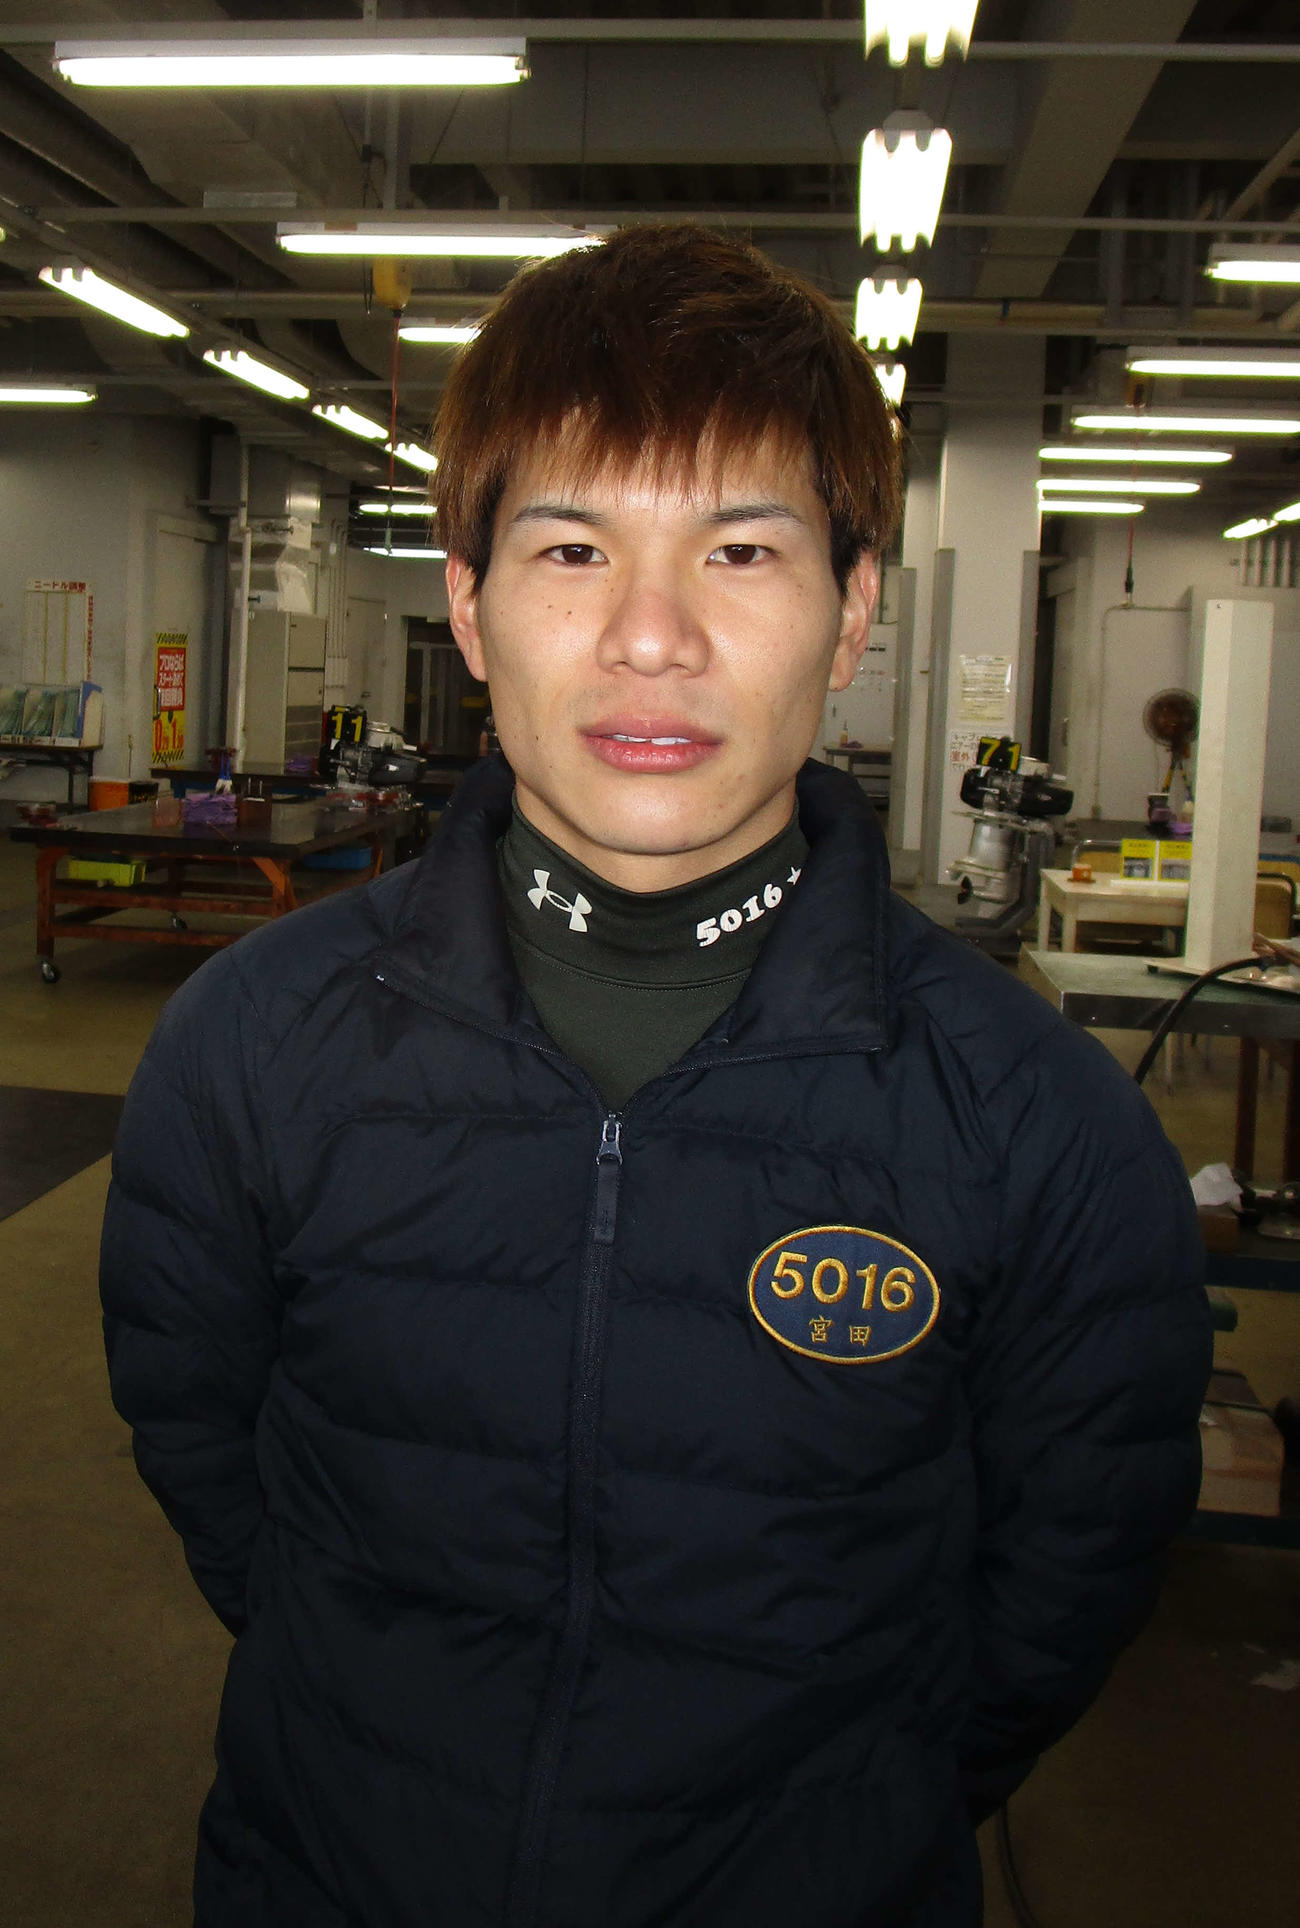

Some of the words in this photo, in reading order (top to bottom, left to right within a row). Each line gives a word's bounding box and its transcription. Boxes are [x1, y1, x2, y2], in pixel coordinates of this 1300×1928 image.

[332, 713, 363, 743] 11
[980, 736, 1021, 771] 71
[696, 883, 783, 947] 5016
[770, 1251, 916, 1313] 5016
